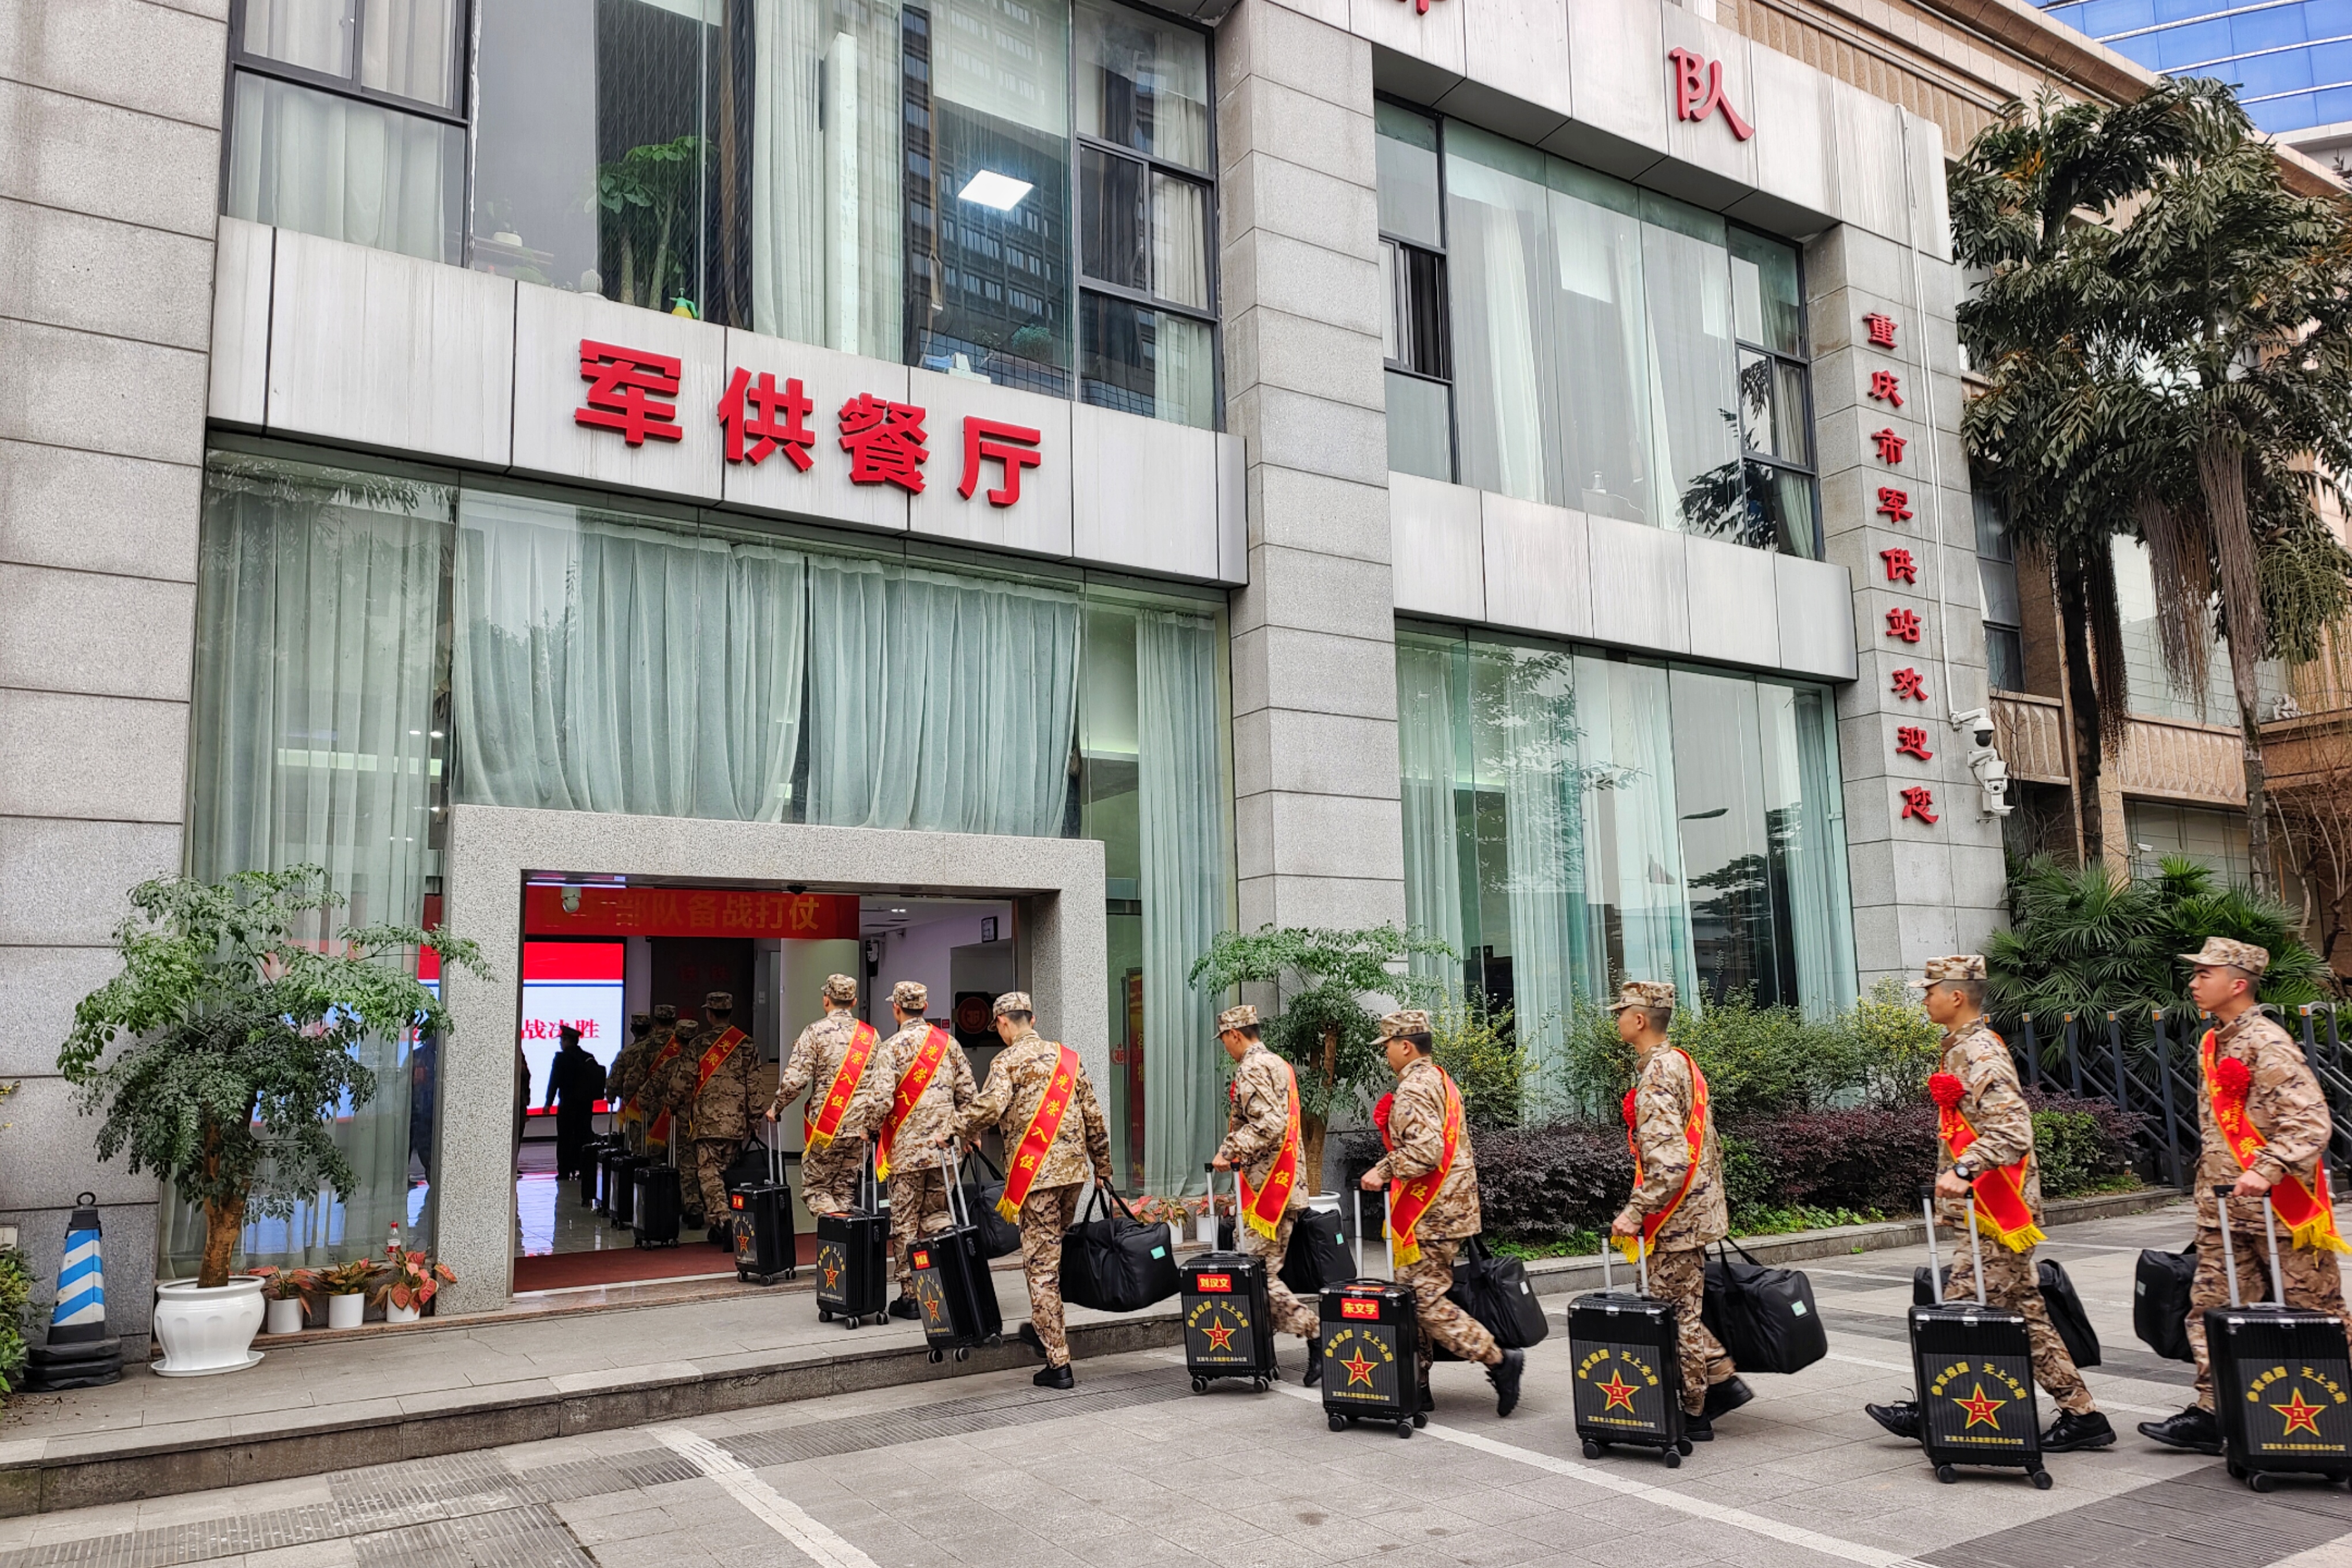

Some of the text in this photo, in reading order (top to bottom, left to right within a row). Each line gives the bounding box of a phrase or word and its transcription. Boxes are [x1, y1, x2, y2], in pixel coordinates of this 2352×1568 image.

[575, 338, 1041, 508] 军供餐厅
[1863, 312, 1939, 824] 重庆市军供站欢迎您
[831, 1031, 869, 1109] 光荣入伍
[888, 1045, 937, 1128] 光荣入伍
[1020, 1073, 1068, 1171] 光荣入伍
[1344, 1302, 1377, 1315] 朱文学
